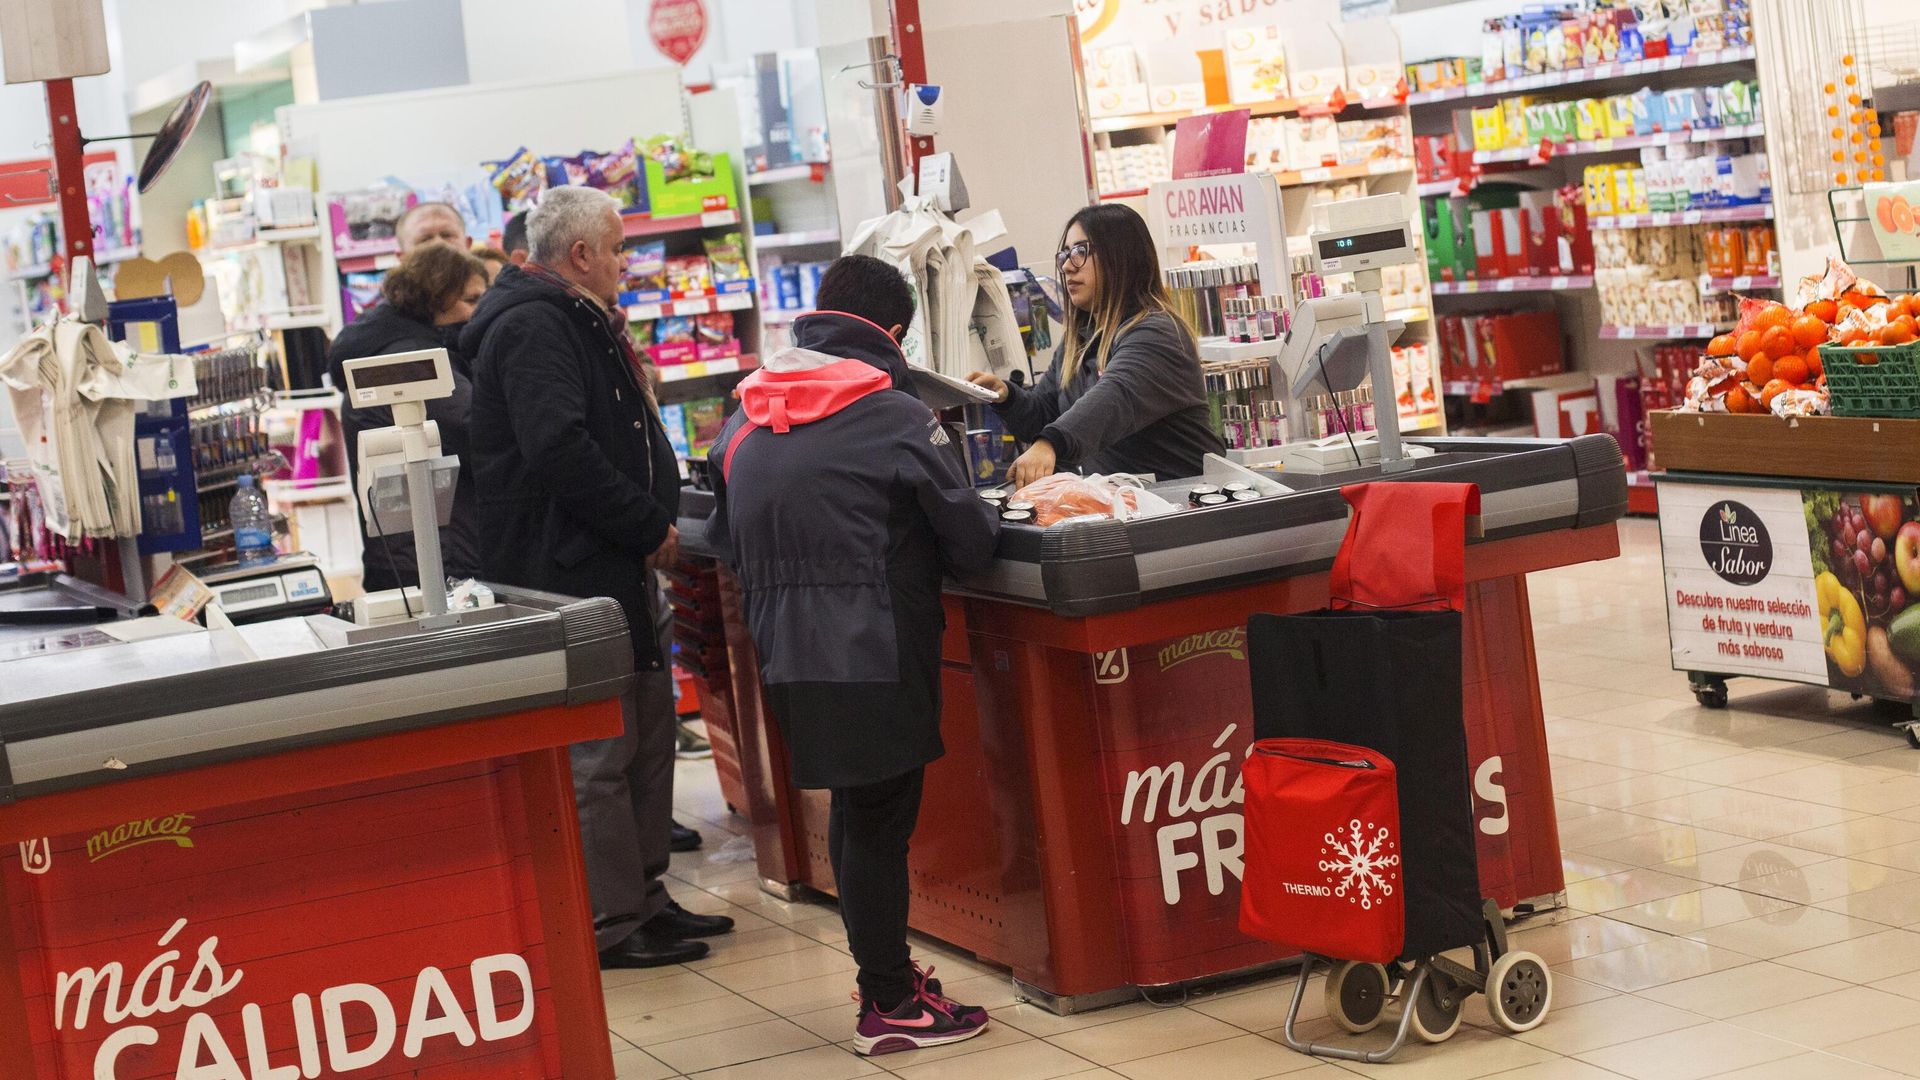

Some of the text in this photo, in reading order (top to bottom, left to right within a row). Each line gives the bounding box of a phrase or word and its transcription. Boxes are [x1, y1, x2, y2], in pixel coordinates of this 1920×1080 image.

[1166, 184, 1244, 218] CARAVAN
[1169, 219, 1246, 237] FRAGANCIAS
[1712, 546, 1766, 576] Sabor
[1676, 590, 1812, 617] Descubre nuestra selección
[1702, 614, 1793, 638] de fruta y verdura
[1158, 626, 1247, 668] market
[1718, 638, 1784, 660] más sabrosa
[86, 813, 196, 856] market
[1282, 882, 1331, 897] THERMO
[55, 917, 244, 1030] más
[93, 953, 535, 1080] CALIDAD
